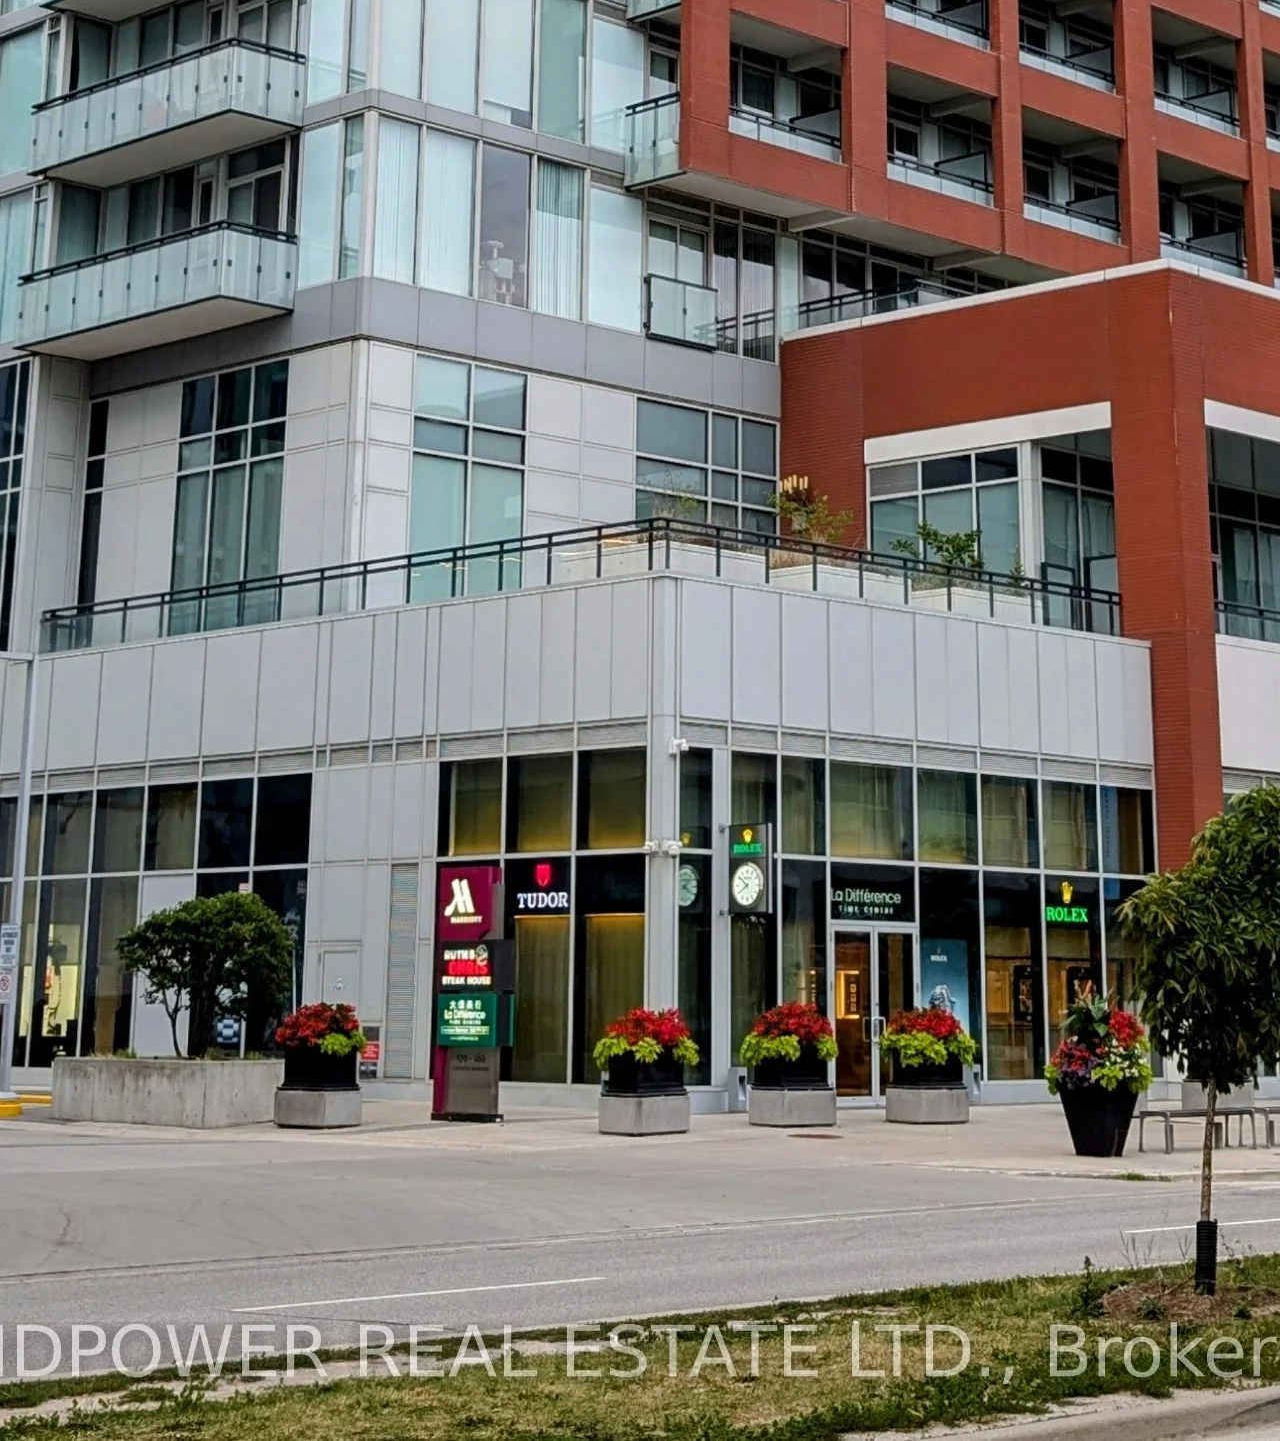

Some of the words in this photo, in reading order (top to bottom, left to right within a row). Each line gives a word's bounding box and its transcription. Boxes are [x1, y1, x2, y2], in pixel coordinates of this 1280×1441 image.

[733, 843, 763, 854] ROLEX
[517, 892, 569, 909] TUDOR
[845, 888, 902, 904] Différence
[1045, 906, 1089, 923] ROLEX
